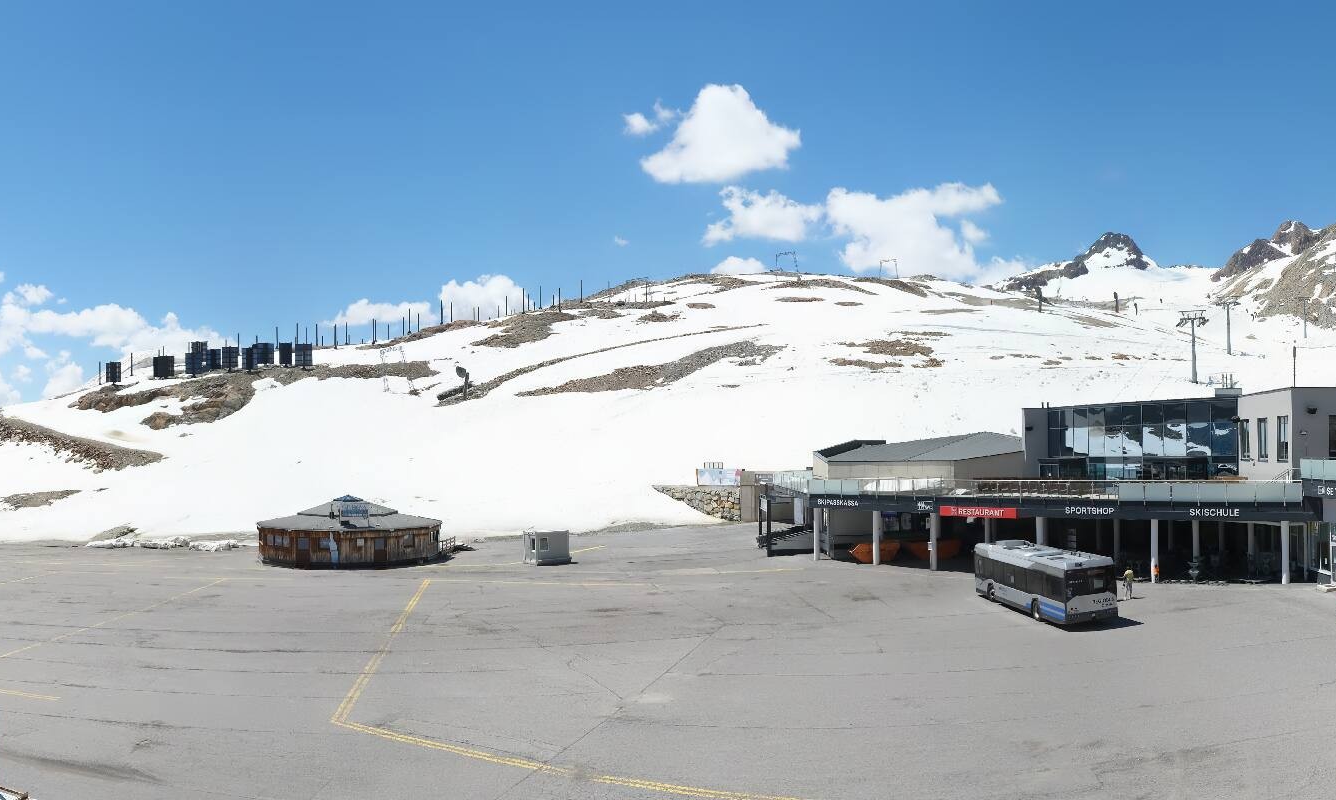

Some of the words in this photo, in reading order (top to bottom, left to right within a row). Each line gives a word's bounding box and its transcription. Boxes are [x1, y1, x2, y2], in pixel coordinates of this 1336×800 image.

[817, 498, 859, 507] SKIPASSKASSA
[958, 508, 1004, 517] RESTAURANT
[1065, 506, 1115, 515] SPORTSHOP
[1189, 508, 1240, 517] SKISCHULE
